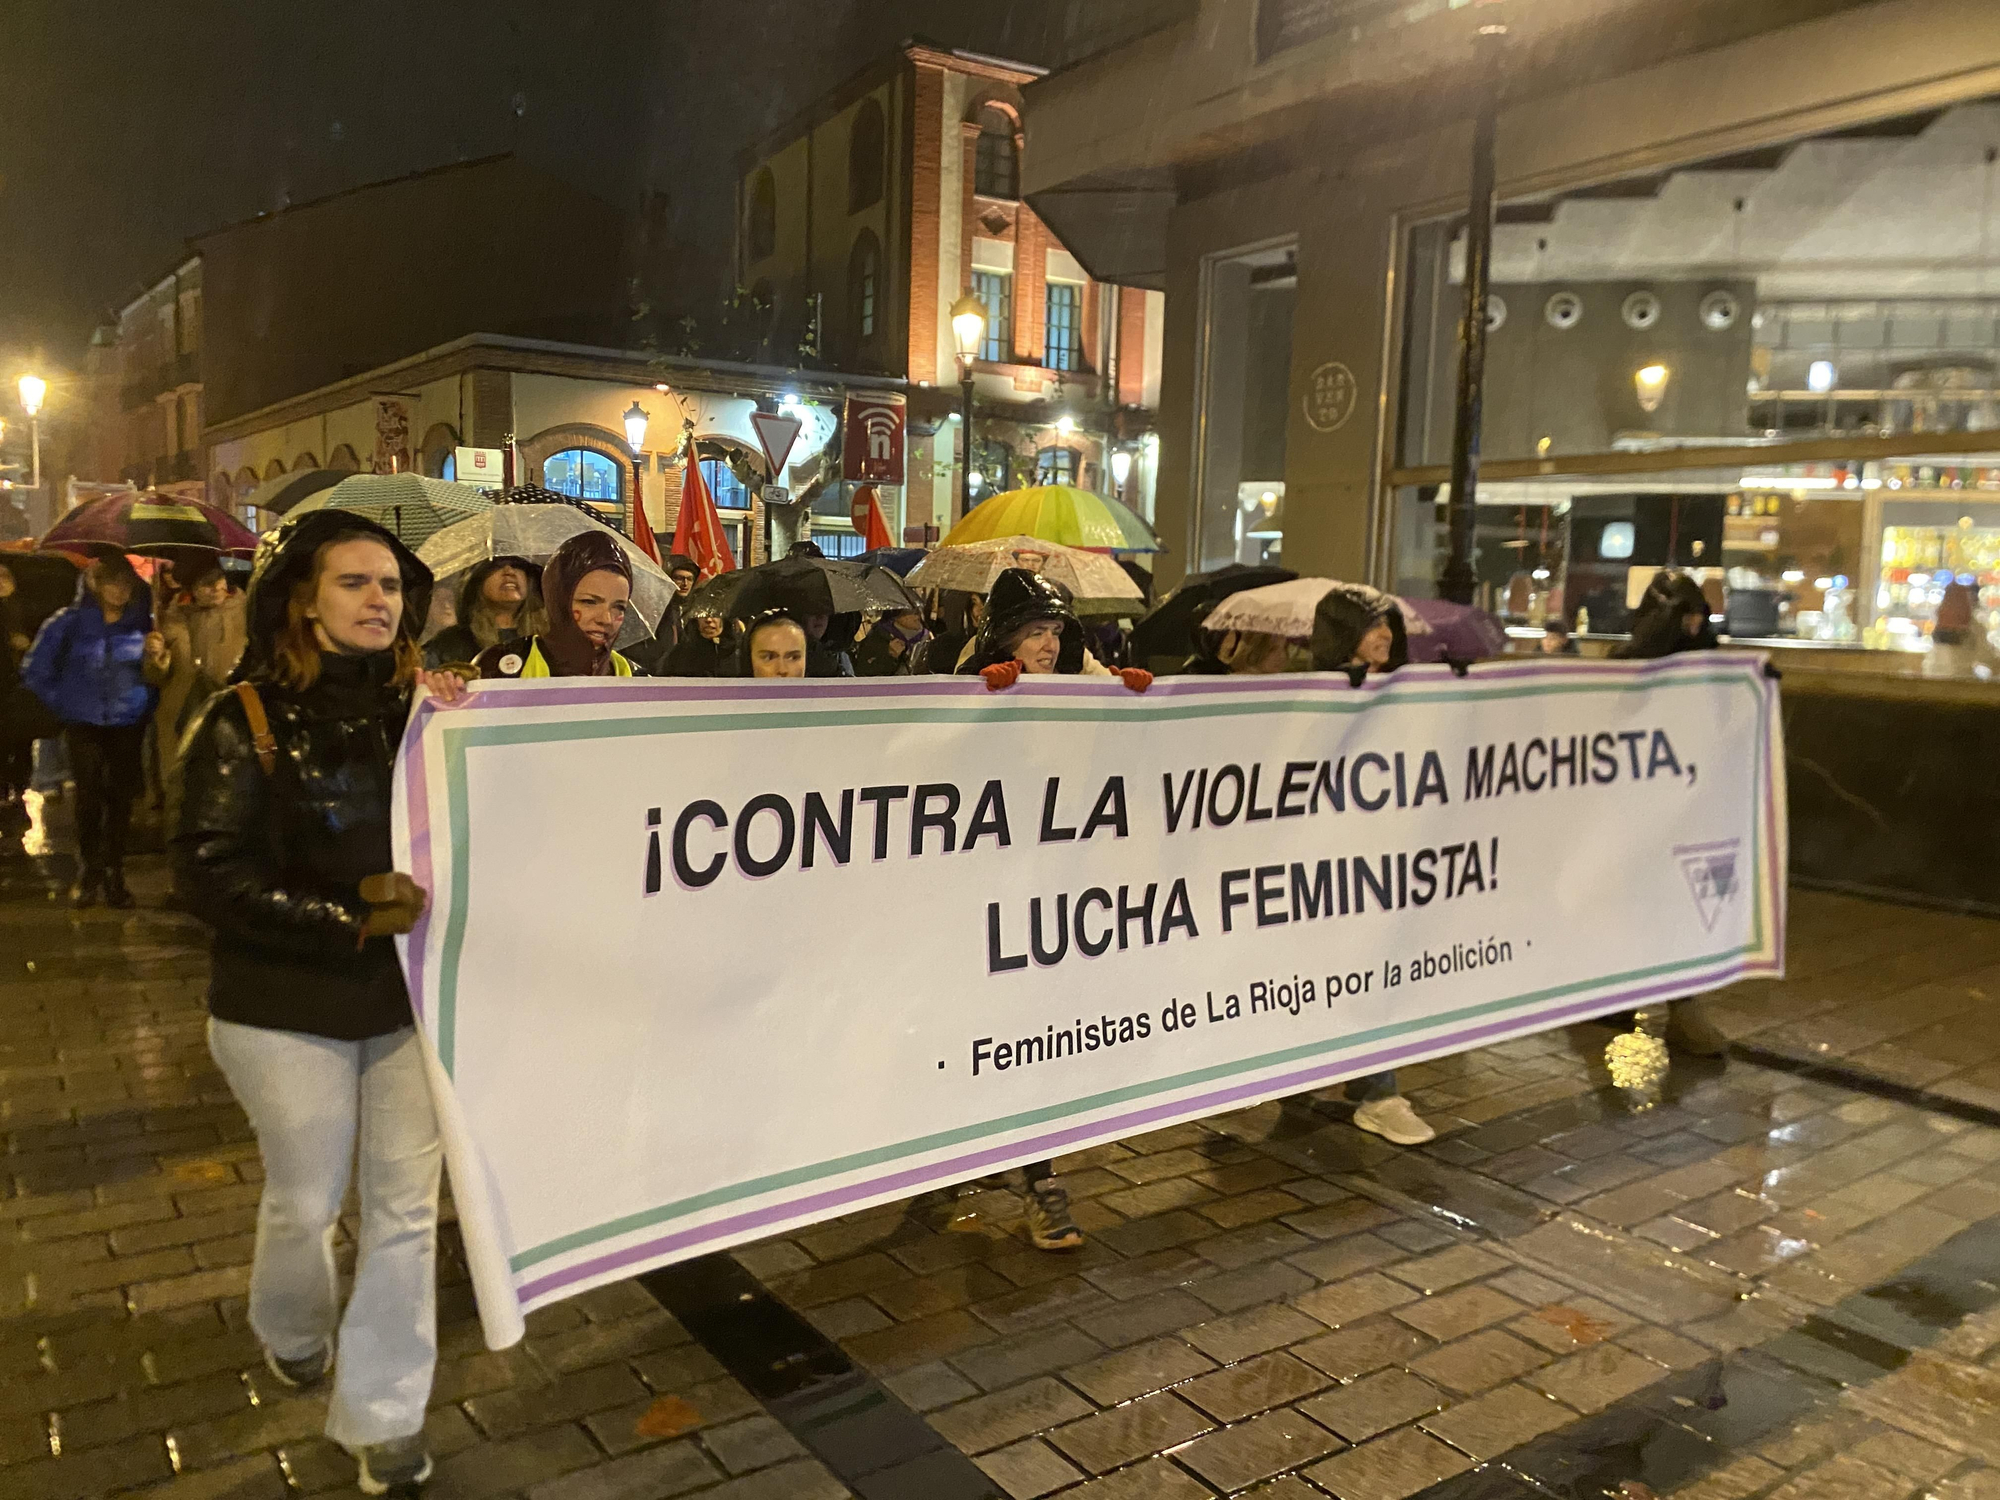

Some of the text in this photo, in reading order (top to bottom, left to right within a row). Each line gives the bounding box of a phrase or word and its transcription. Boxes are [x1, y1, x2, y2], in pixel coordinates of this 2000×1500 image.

[643, 728, 1697, 896] ¡CONTRA LA VIOLENCIA MACHISTA,
[986, 836, 1499, 975] LUCHA FEMINISTA!
[972, 936, 1513, 1077] Feministas de La Rioja por la abolición
